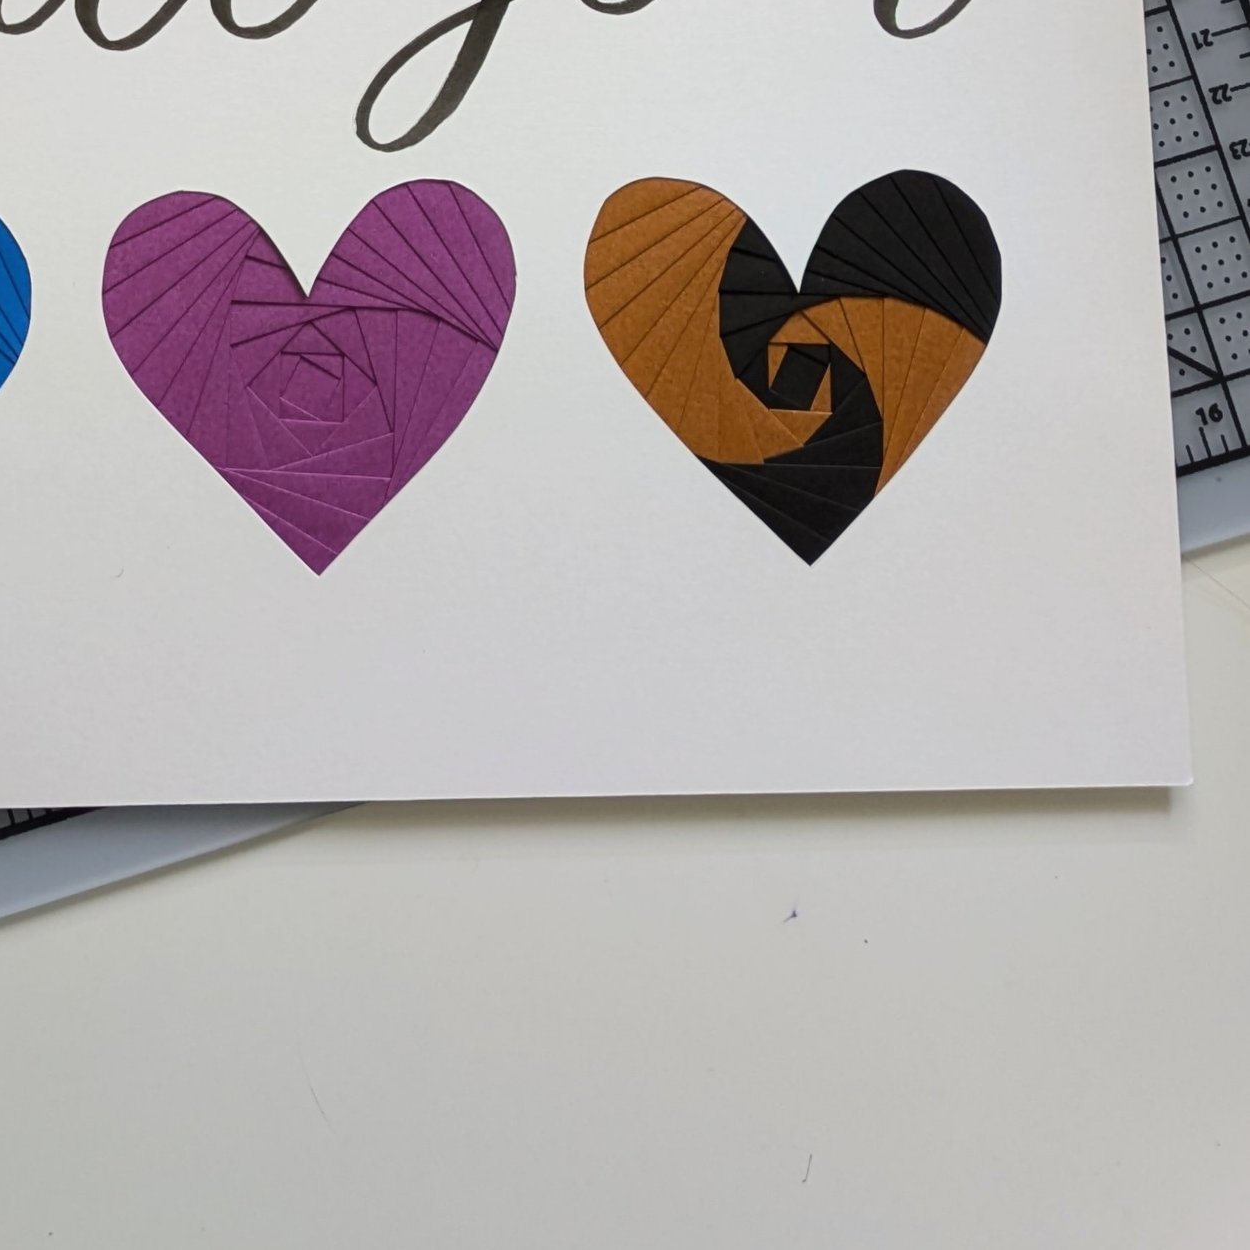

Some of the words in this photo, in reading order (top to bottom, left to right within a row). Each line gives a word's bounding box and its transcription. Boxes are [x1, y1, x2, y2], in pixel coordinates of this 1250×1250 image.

[1191, 29, 1213, 50] 21
[1209, 84, 1232, 105] 22
[1229, 138, 1250, 160] 23
[1196, 403, 1223, 426] 16
